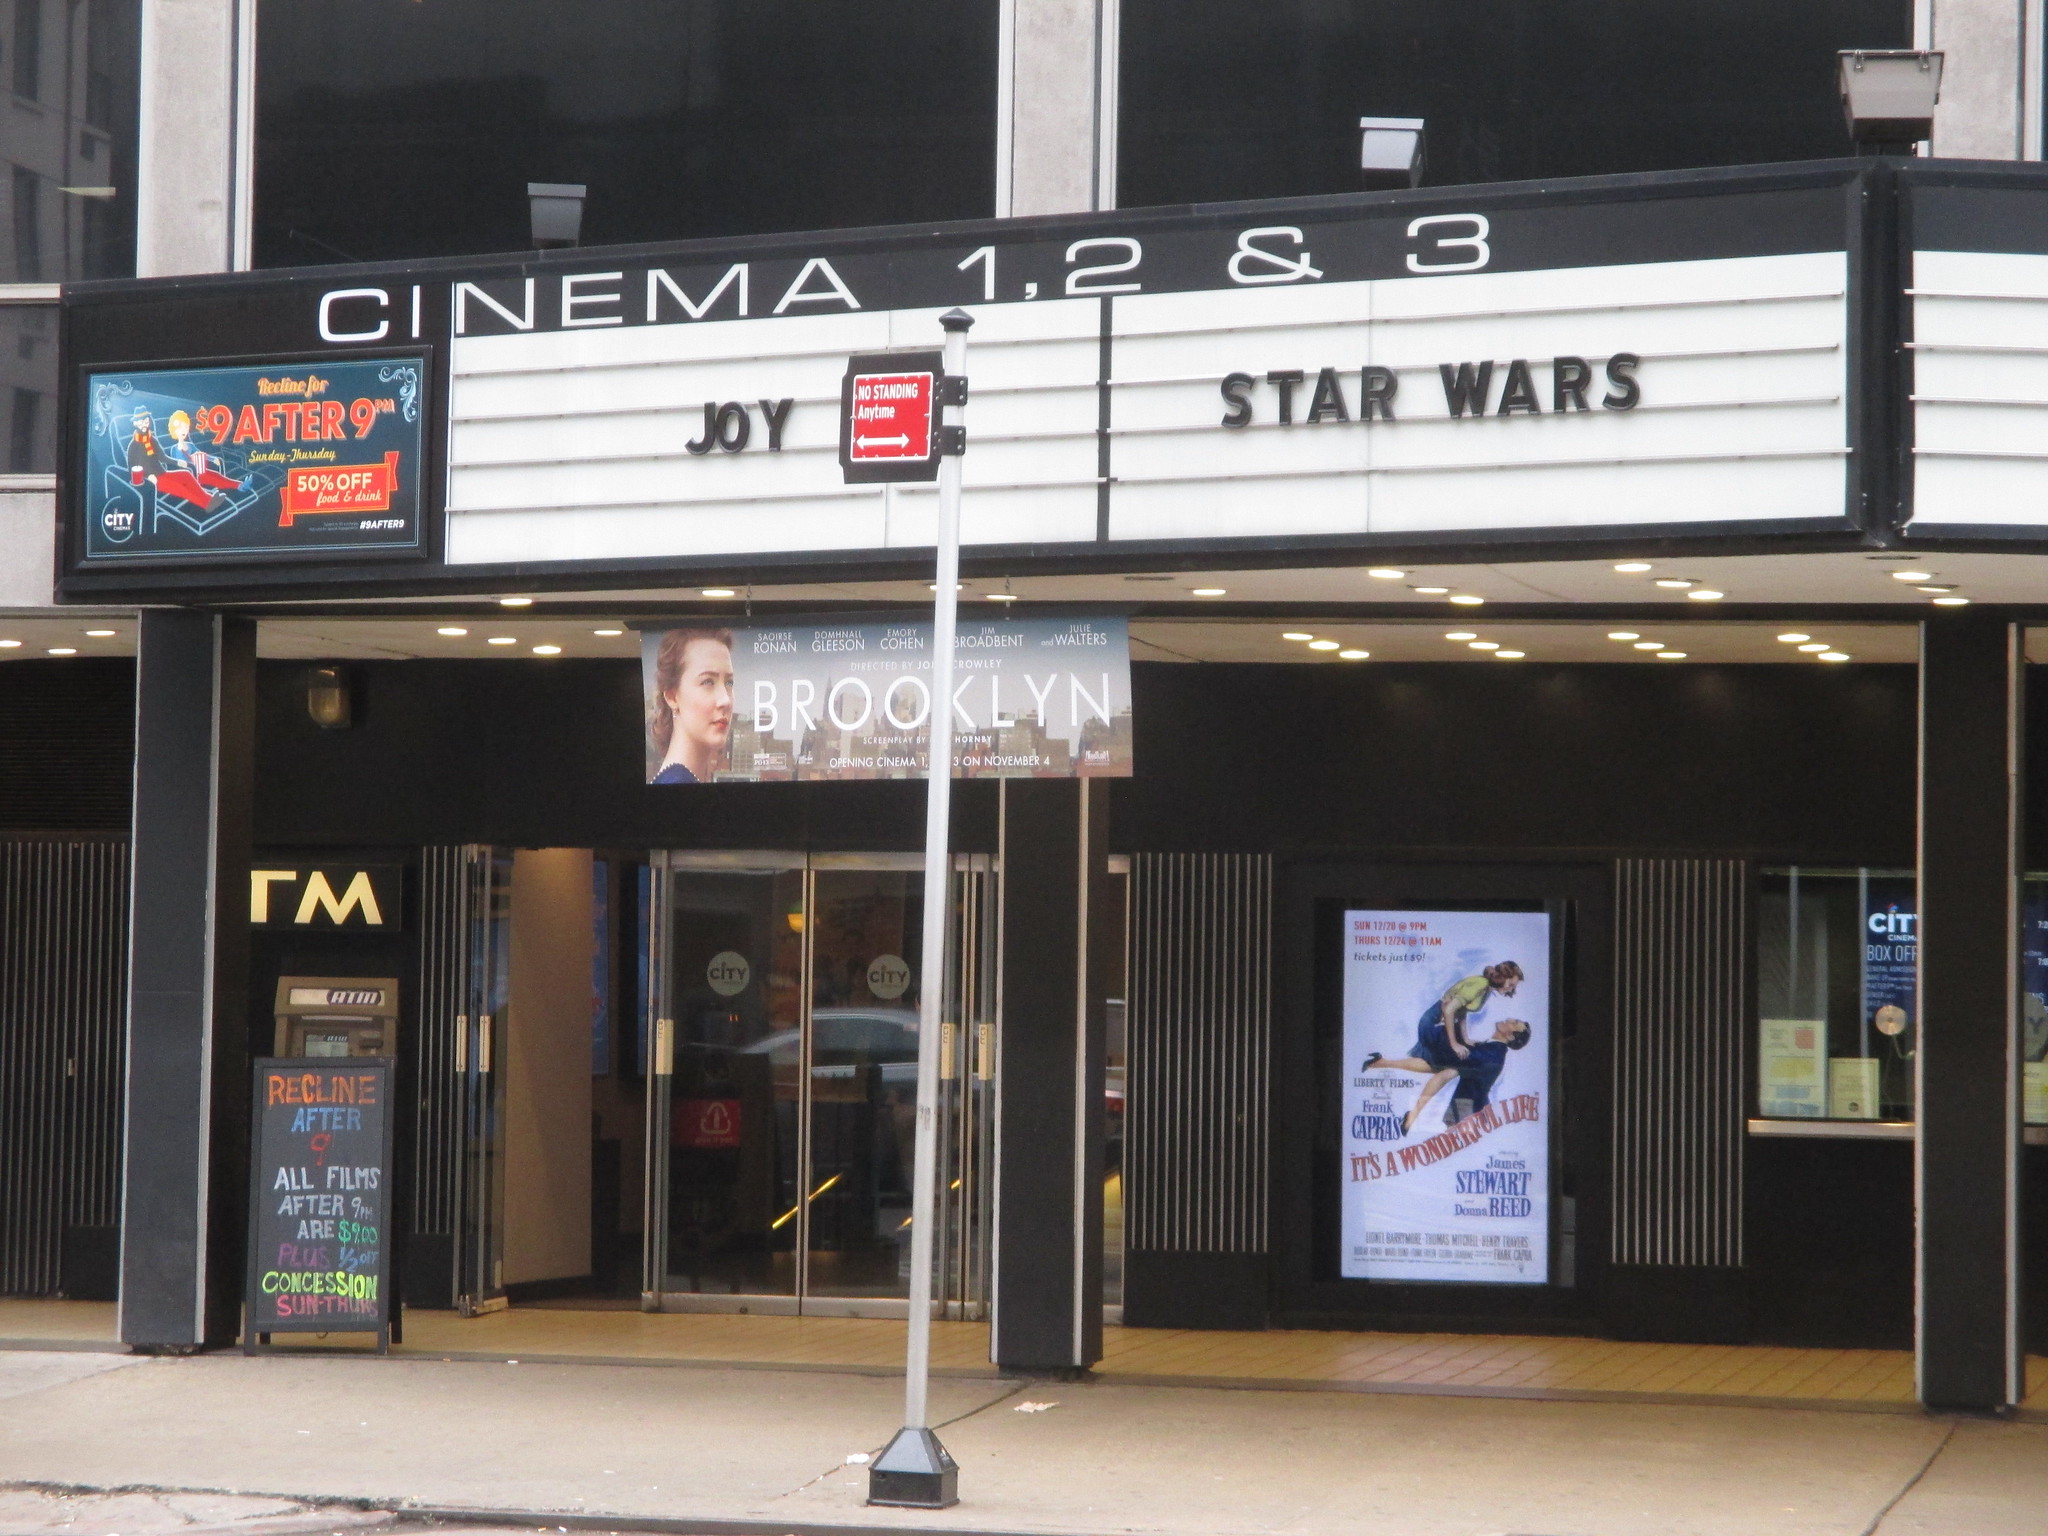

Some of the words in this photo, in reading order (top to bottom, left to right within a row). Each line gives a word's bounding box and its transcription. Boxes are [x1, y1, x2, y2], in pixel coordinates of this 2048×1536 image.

[319, 257, 861, 342] CINEMA
[1228, 225, 1323, 284] &
[1408, 213, 1490, 274] 3
[257, 376, 306, 396] Recline
[304, 375, 329, 398] for
[858, 384, 871, 401] NO
[873, 382, 919, 400] STANDING
[1220, 365, 1399, 430] STAR
[1439, 352, 1642, 420] WARS
[857, 404, 896, 422] Anytime
[195, 404, 234, 446] $9
[232, 400, 347, 445] AFTER
[684, 397, 794, 455] JOY
[248, 447, 337, 464] Sunday-Thursday
[297, 474, 335, 492] 50%
[336, 472, 373, 491] OFF
[316, 490, 340, 507] food
[343, 490, 352, 503] &
[354, 489, 382, 503] drink
[104, 511, 134, 526] CITY
[360, 519, 405, 530] #9AFTER9
[757, 631, 793, 642] SAOIRSE
[814, 629, 863, 640] DOMHNALL
[886, 628, 918, 638] EMORY
[980, 626, 996, 635] JIM
[1069, 623, 1092, 633] JULIE
[753, 641, 797, 654] RONAN
[811, 638, 865, 652] GLEESON
[879, 637, 925, 651] COHEN
[953, 634, 1024, 648] BROADBENT
[1041, 637, 1054, 646] and
[1054, 632, 1108, 647] WALTERS
[850, 661, 898, 672] DIRECTED
[901, 660, 914, 671] BY
[916, 659, 935, 671] JO
[753, 672, 1111, 733] BROOKLYN
[863, 735, 913, 745] SCREENPLAY
[916, 735, 926, 744] BY
[954, 735, 993, 744] HORNBY
[829, 756, 874, 768] OPENING
[876, 755, 917, 767] CINEMA
[953, 755, 960, 767] 3
[963, 755, 981, 767] ON
[984, 754, 1040, 767] NOVEMBER
[1043, 754, 1050, 767] 4
[250, 870, 383, 925] TM
[1354, 920, 1371, 931] SUN
[1398, 921, 1407, 932] @
[1409, 921, 1427, 932] 9PM
[1867, 912, 1917, 933] CIT
[1354, 935, 1381, 945] THURS
[1384, 936, 1406, 946] 12/24
[1408, 937, 1417, 947] @
[1421, 936, 1442, 946] 11AM
[1887, 934, 1917, 942] CINEM
[1354, 951, 1387, 962] tickets
[1388, 952, 1407, 964] just
[1866, 944, 1892, 961] BOX
[1895, 944, 1917, 961] OFF
[709, 963, 747, 981] CITY
[869, 967, 908, 984] CITY
[331, 991, 379, 1004] ATM
[267, 1073, 377, 1106] RECLINE
[1353, 1078, 1384, 1088] LIBERTY
[1389, 1078, 1415, 1089] FILMS
[1362, 1100, 1393, 1114] Frank
[291, 1107, 362, 1133] AFTER
[1351, 1114, 1402, 1142] CAPRA'S
[1385, 1152, 1401, 1177] A
[1398, 1103, 1503, 1174] WONDERFUL
[309, 1132, 332, 1167] 9
[1485, 1155, 1526, 1170] James
[273, 1166, 315, 1191] ALL
[326, 1165, 381, 1191] FILMS
[1456, 1169, 1532, 1197] STEWART
[277, 1193, 345, 1217] AFTER
[1454, 1203, 1488, 1217] Donna
[1488, 1197, 1532, 1218] REED
[296, 1219, 335, 1239] ARE
[277, 1242, 331, 1270] PLUS
[262, 1270, 379, 1300] CONCESSION
[276, 1294, 380, 1318] SUN-THURS
